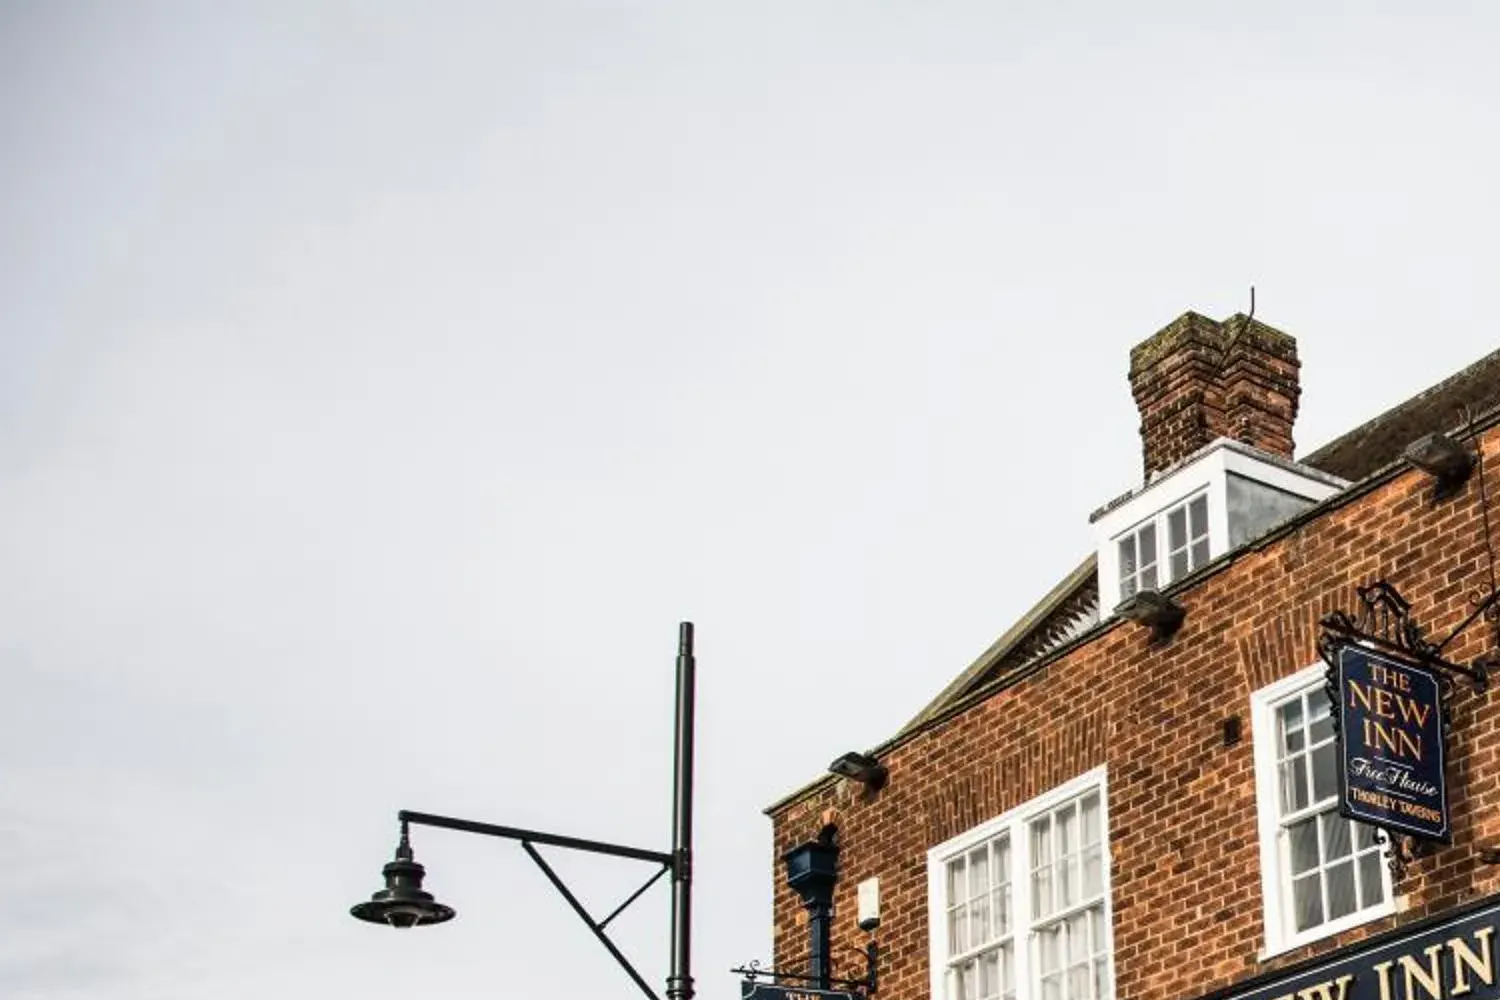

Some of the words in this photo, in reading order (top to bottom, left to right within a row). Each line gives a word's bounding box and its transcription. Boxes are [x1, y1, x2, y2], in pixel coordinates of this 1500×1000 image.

[1367, 662, 1411, 692] THE
[1348, 679, 1430, 729] NEW
[1362, 718, 1422, 762] INN
[1350, 756, 1387, 782] Free
[1384, 767, 1438, 797] House
[1351, 786, 1396, 811] THORLEY
[1399, 800, 1441, 823] TAVERNS
